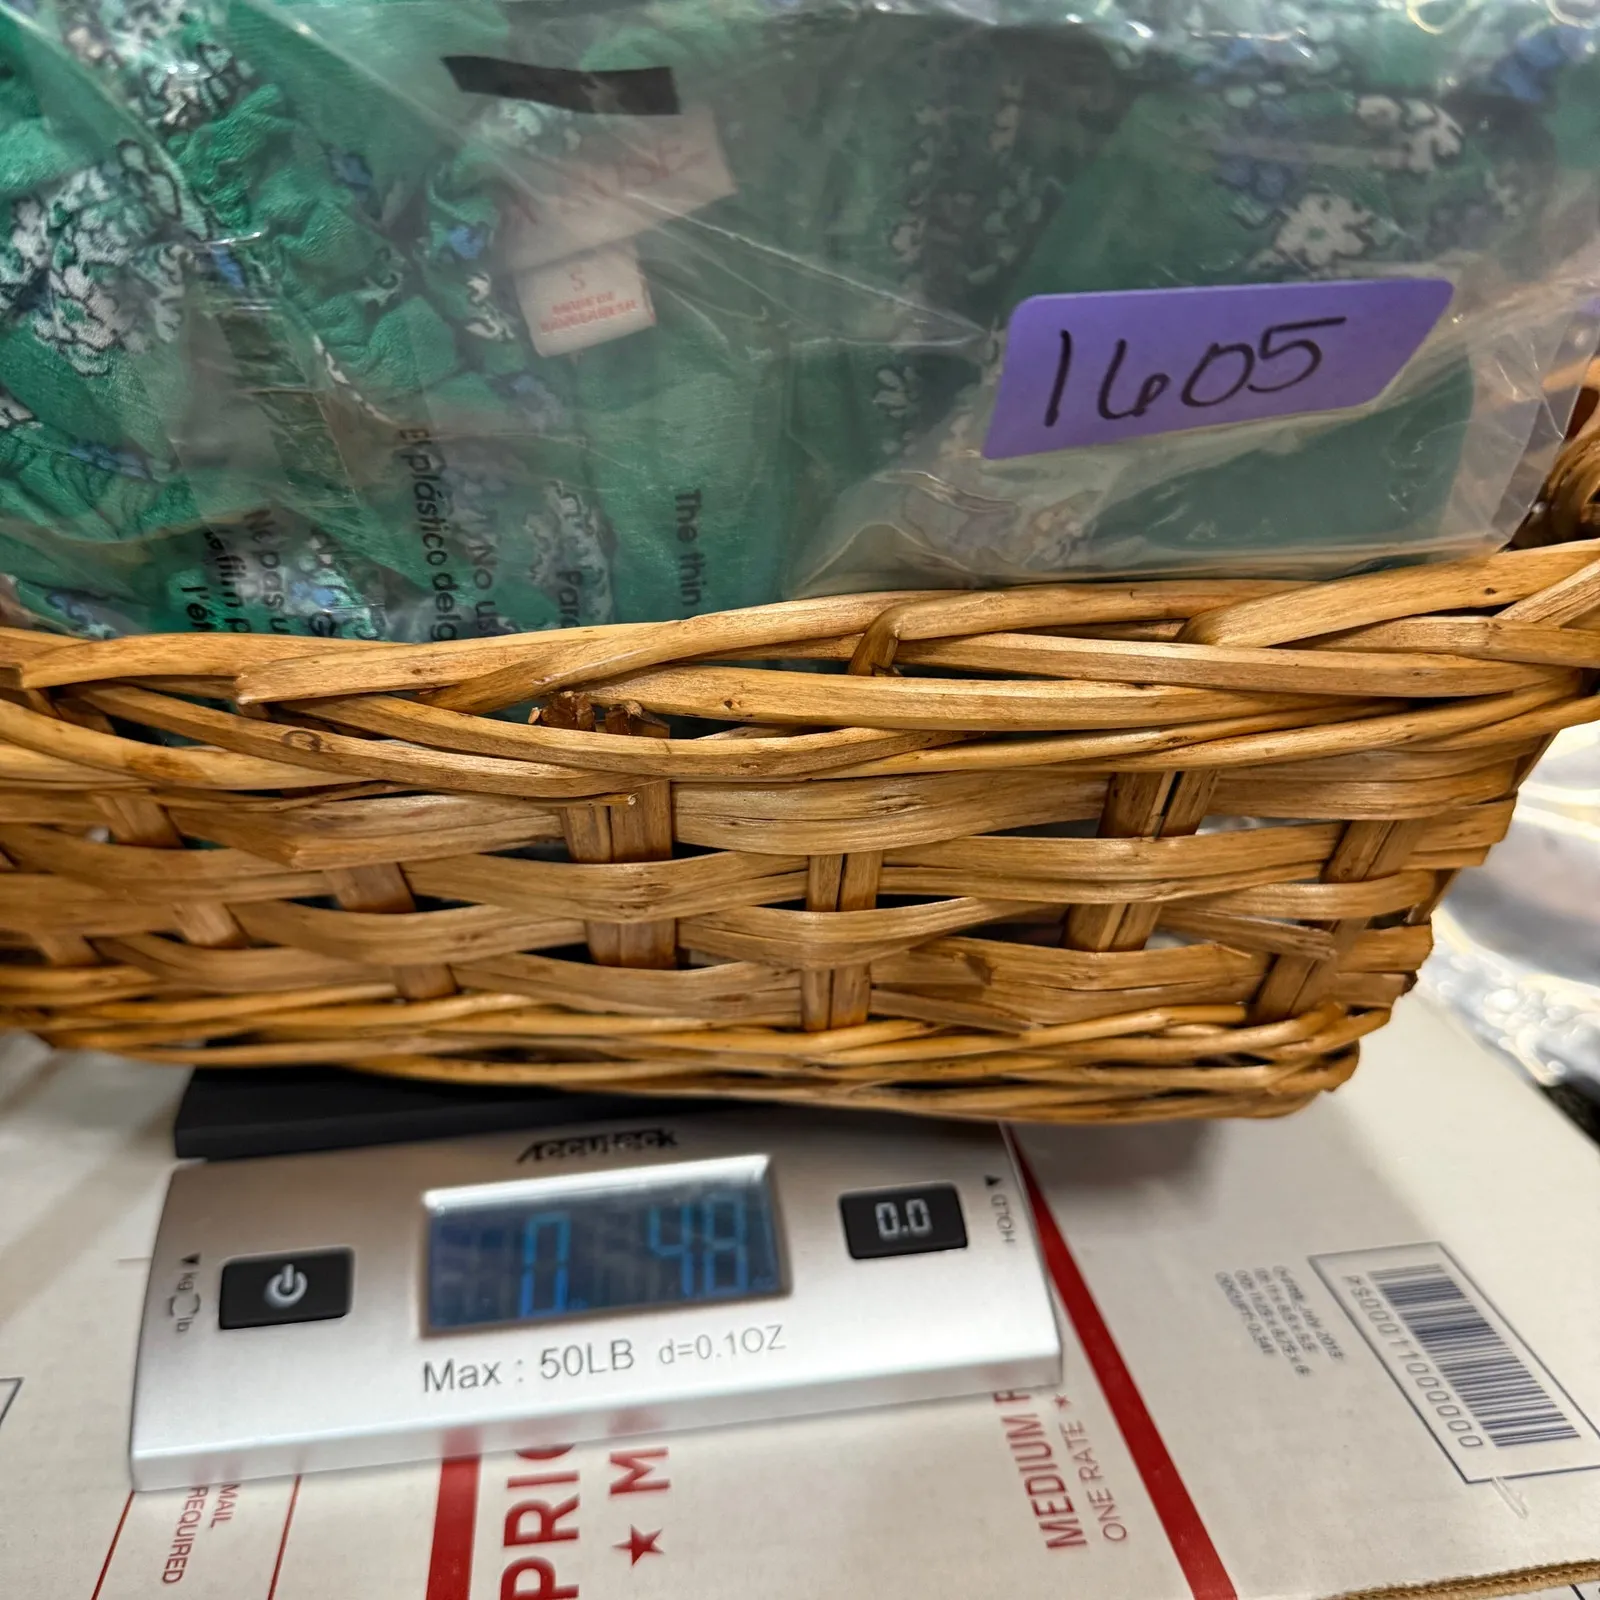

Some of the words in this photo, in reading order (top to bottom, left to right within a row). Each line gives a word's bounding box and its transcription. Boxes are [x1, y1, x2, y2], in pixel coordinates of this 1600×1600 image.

[1045, 317, 1347, 427] 1605
[400, 453, 450, 566] plástico
[675, 489, 703, 541] The
[468, 545, 497, 590] No
[681, 553, 707, 606] thin
[875, 1198, 933, 1240] 0.0
[991, 1194, 1017, 1243] HOLD
[424, 1358, 502, 1393] Max
[540, 1340, 635, 1380] 50LB
[1059, 1419, 1104, 1482] RATE
[211, 1483, 241, 1529] MAIL
[1001, 1413, 1088, 1549] MEDIUM
[161, 1486, 209, 1585] REQUIRED
[1087, 1488, 1128, 1542] ONE
